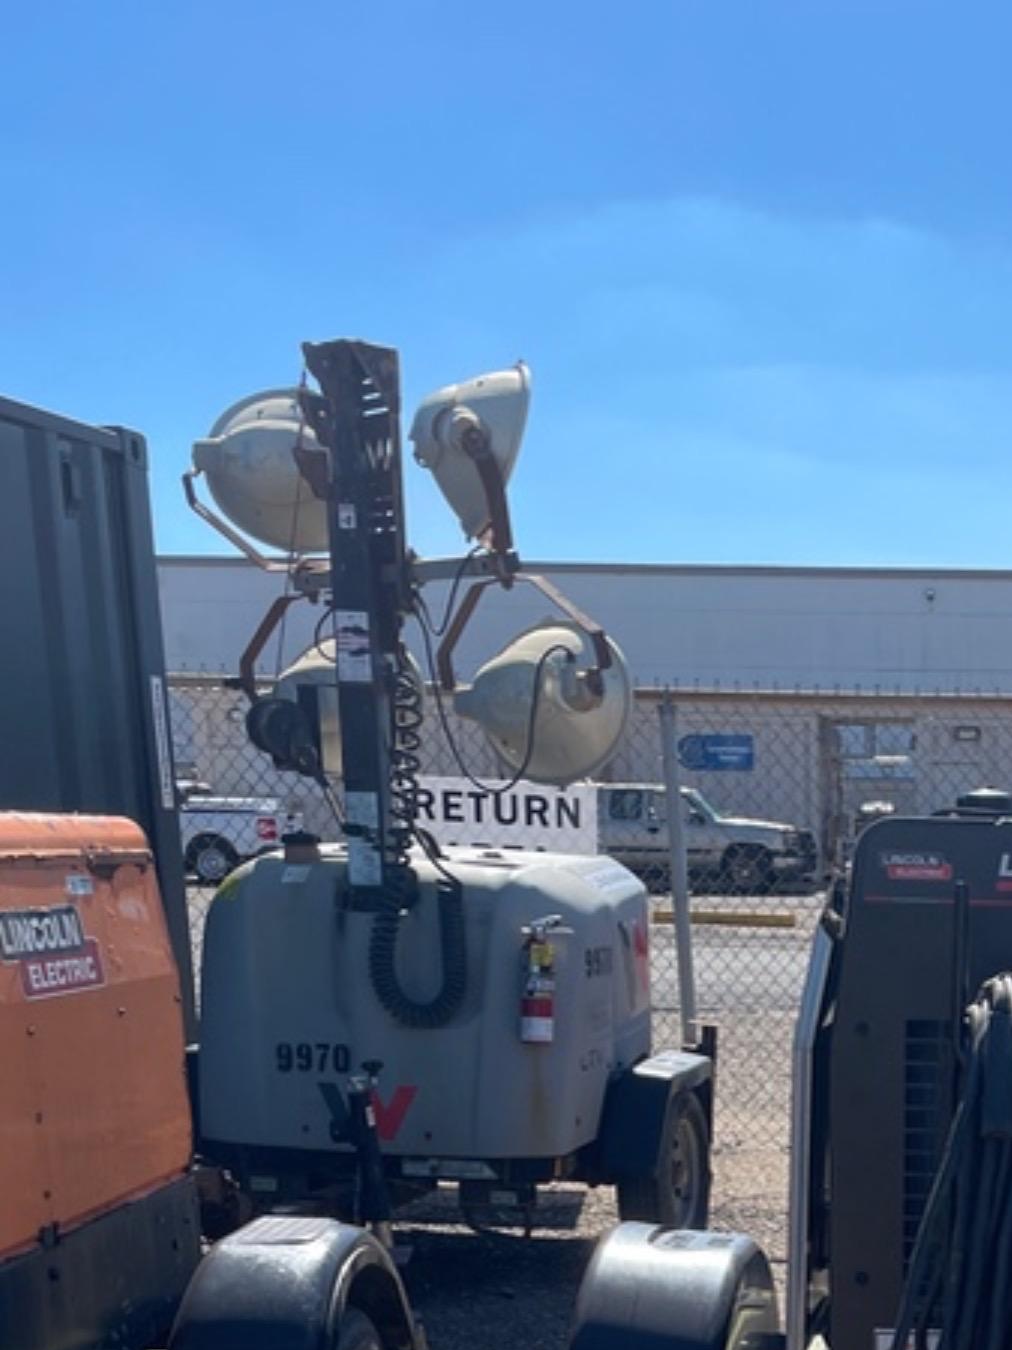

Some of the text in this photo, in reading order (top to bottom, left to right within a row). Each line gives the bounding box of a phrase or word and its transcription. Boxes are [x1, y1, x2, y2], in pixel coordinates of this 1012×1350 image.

[414, 790, 580, 828] RETURN
[0, 914, 81, 954] LINCOLN
[27, 956, 97, 990] ELECTRIC
[276, 1043, 351, 1073] 9970
